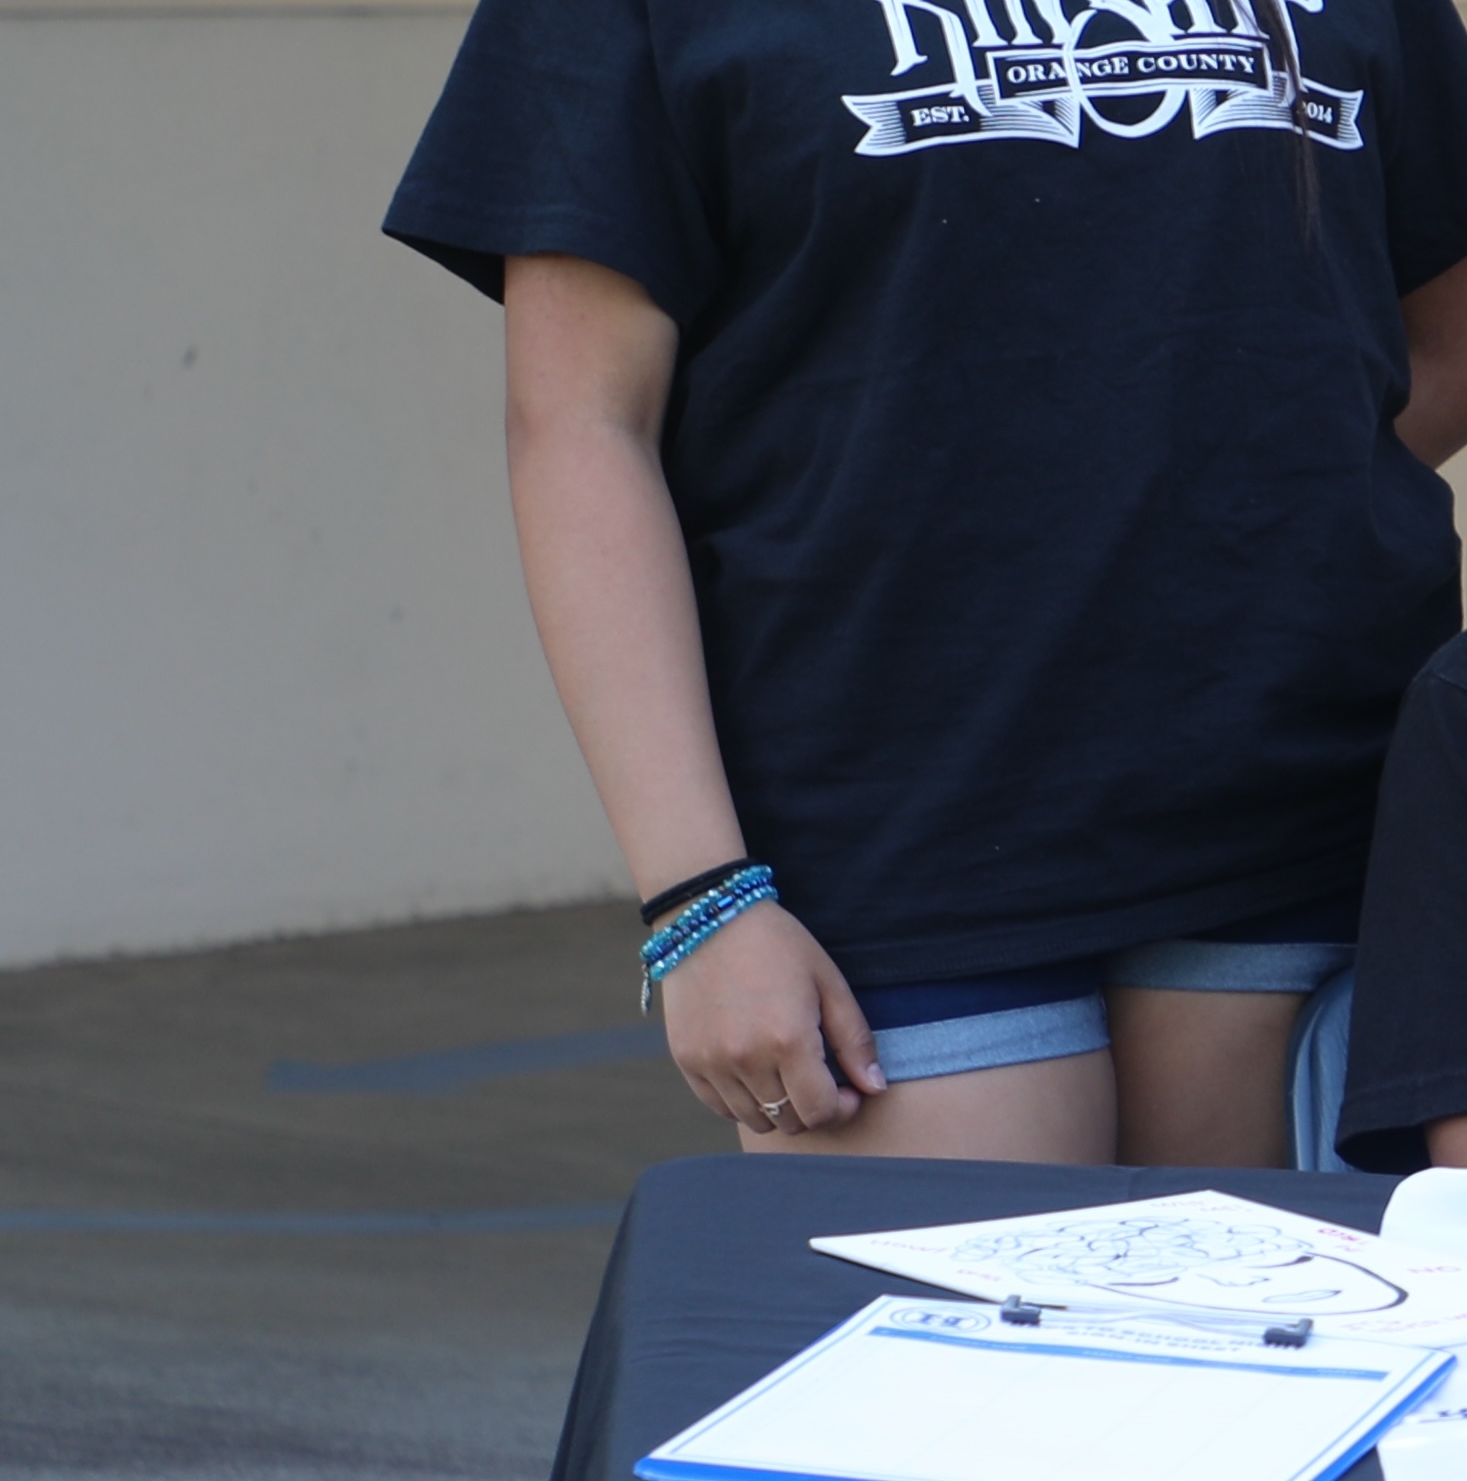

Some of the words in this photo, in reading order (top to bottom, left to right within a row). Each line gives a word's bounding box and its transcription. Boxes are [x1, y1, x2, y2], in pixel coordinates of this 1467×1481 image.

[1006, 55, 1130, 84] ORANGE
[1136, 53, 1255, 75] COUNTY
[911, 106, 970, 127] EST.
